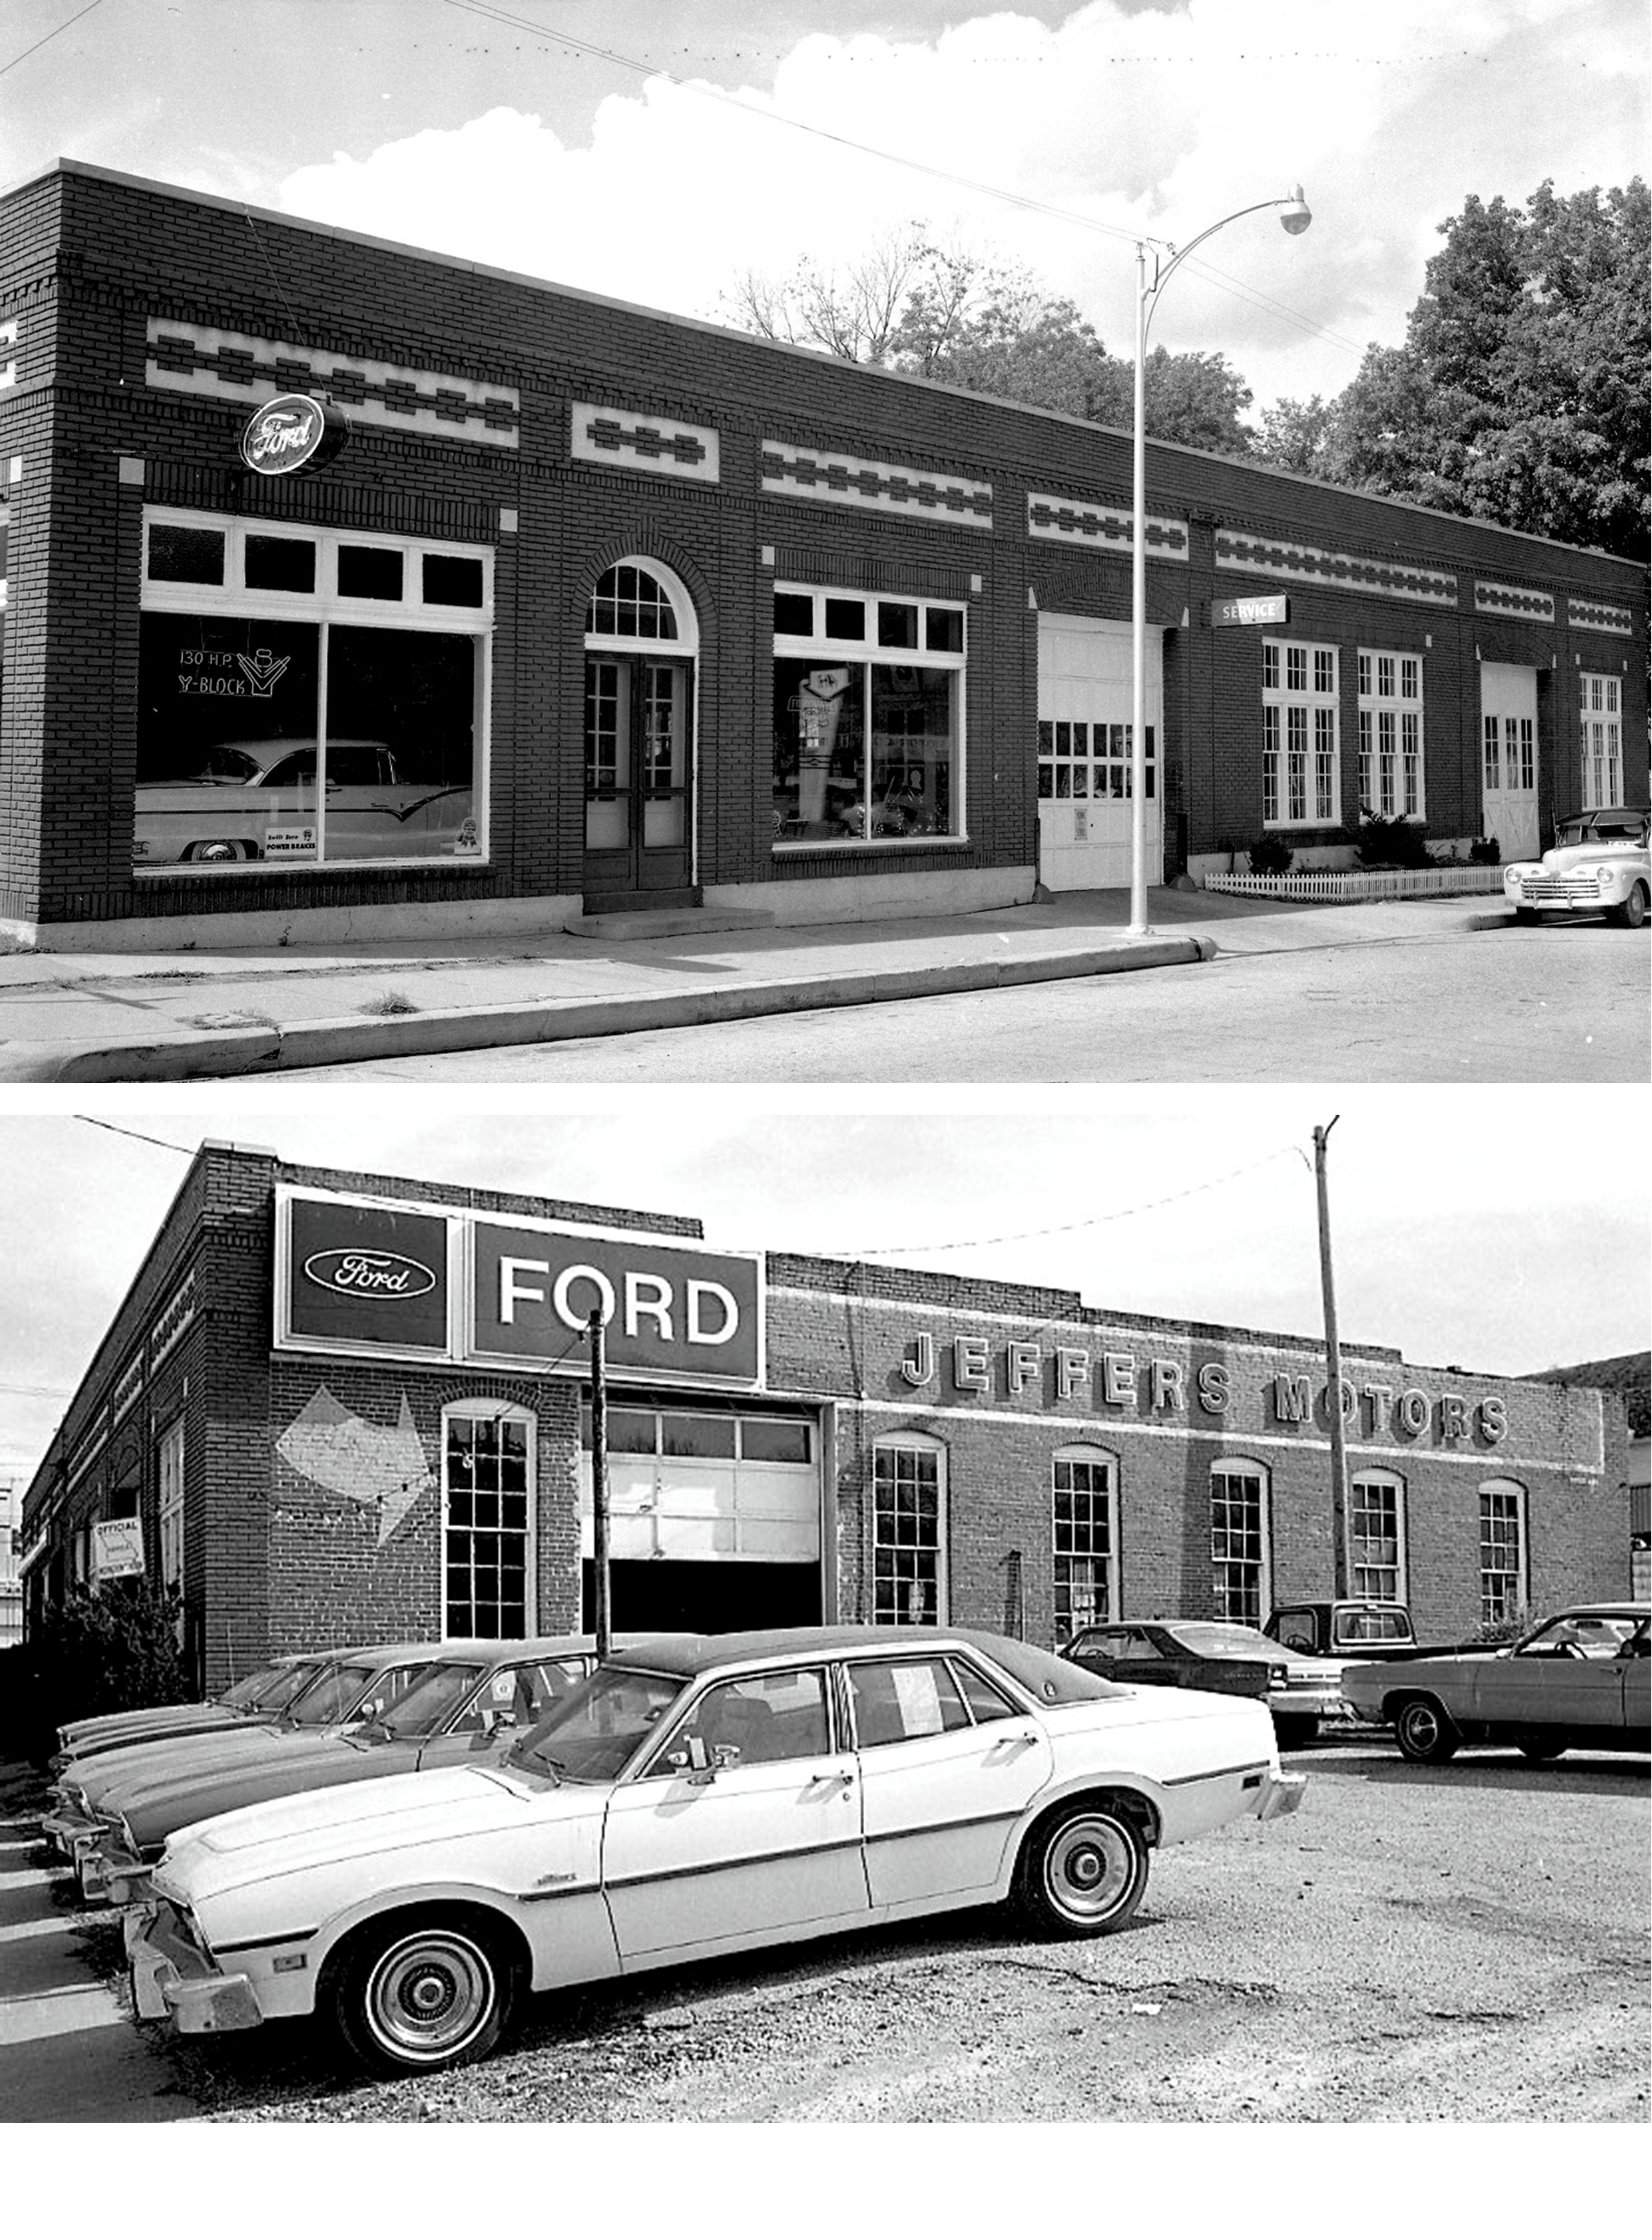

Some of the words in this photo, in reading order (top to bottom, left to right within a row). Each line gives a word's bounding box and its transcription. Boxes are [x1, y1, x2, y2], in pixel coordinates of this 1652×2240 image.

[253, 412, 313, 460] Ford
[1222, 603, 1276, 618] SERVICE
[180, 651, 203, 665] 130
[179, 675, 245, 695] Y-BLOCK
[335, 1255, 409, 1292] Ford
[500, 1256, 738, 1345] FORD
[902, 1333, 1230, 1413] JEFFERS
[1274, 1374, 1507, 1442] MOTORS
[97, 1521, 138, 1536] OFFICIAL
